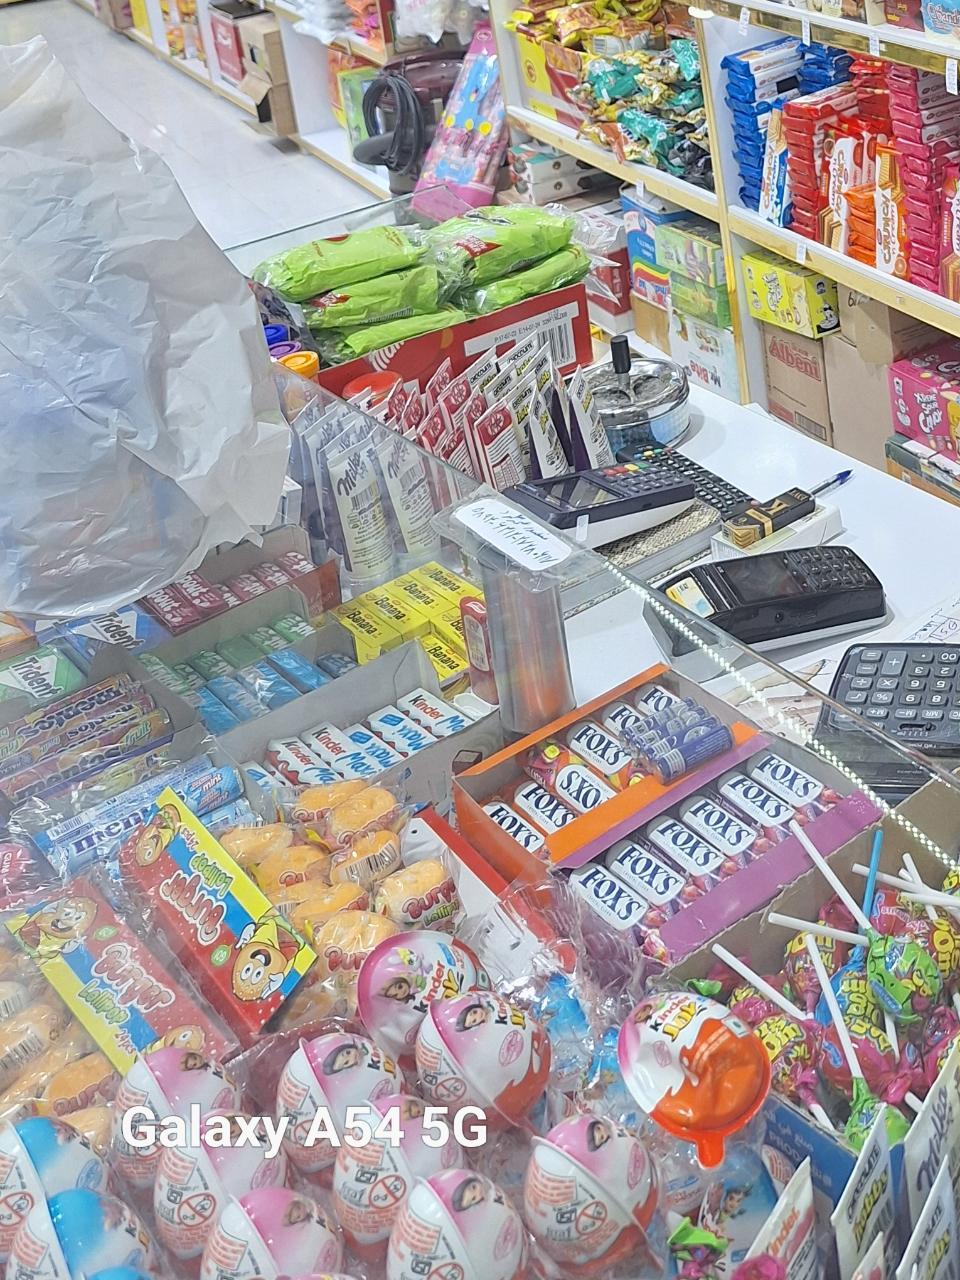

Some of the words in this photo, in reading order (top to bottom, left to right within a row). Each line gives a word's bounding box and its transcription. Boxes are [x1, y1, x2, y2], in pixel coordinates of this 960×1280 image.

[689, 359, 709, 384] Bite
[768, 336, 822, 382] Albeni
[402, 580, 434, 606] Banana
[431, 565, 461, 593] Banana
[95, 610, 146, 649] Trident
[346, 610, 377, 636] Banana
[375, 596, 407, 621] Banana
[15, 654, 64, 697] Trident
[427, 645, 460, 671] Banana
[408, 693, 444, 721] Kinder
[280, 739, 316, 768] Kinder
[311, 726, 346, 757] Kinder
[573, 724, 626, 767] FOX'S
[559, 769, 609, 810] OX'S
[729, 773, 791, 819] FOX'S
[756, 752, 819, 798] FOX'S
[489, 805, 540, 850] FOX'S
[522, 785, 576, 828] FOX'S
[690, 799, 751, 847] FOX'S
[657, 820, 723, 874] FOX'S
[190, 852, 235, 896] Lollipop
[618, 844, 681, 896] FOX'S
[160, 870, 227, 944] Burger
[579, 867, 642, 925] FOX'S
[92, 943, 175, 1012] Burger
[413, 961, 446, 1013] Kinder
[78, 980, 129, 1024] Lollipop
[649, 994, 690, 1032] Kinder
